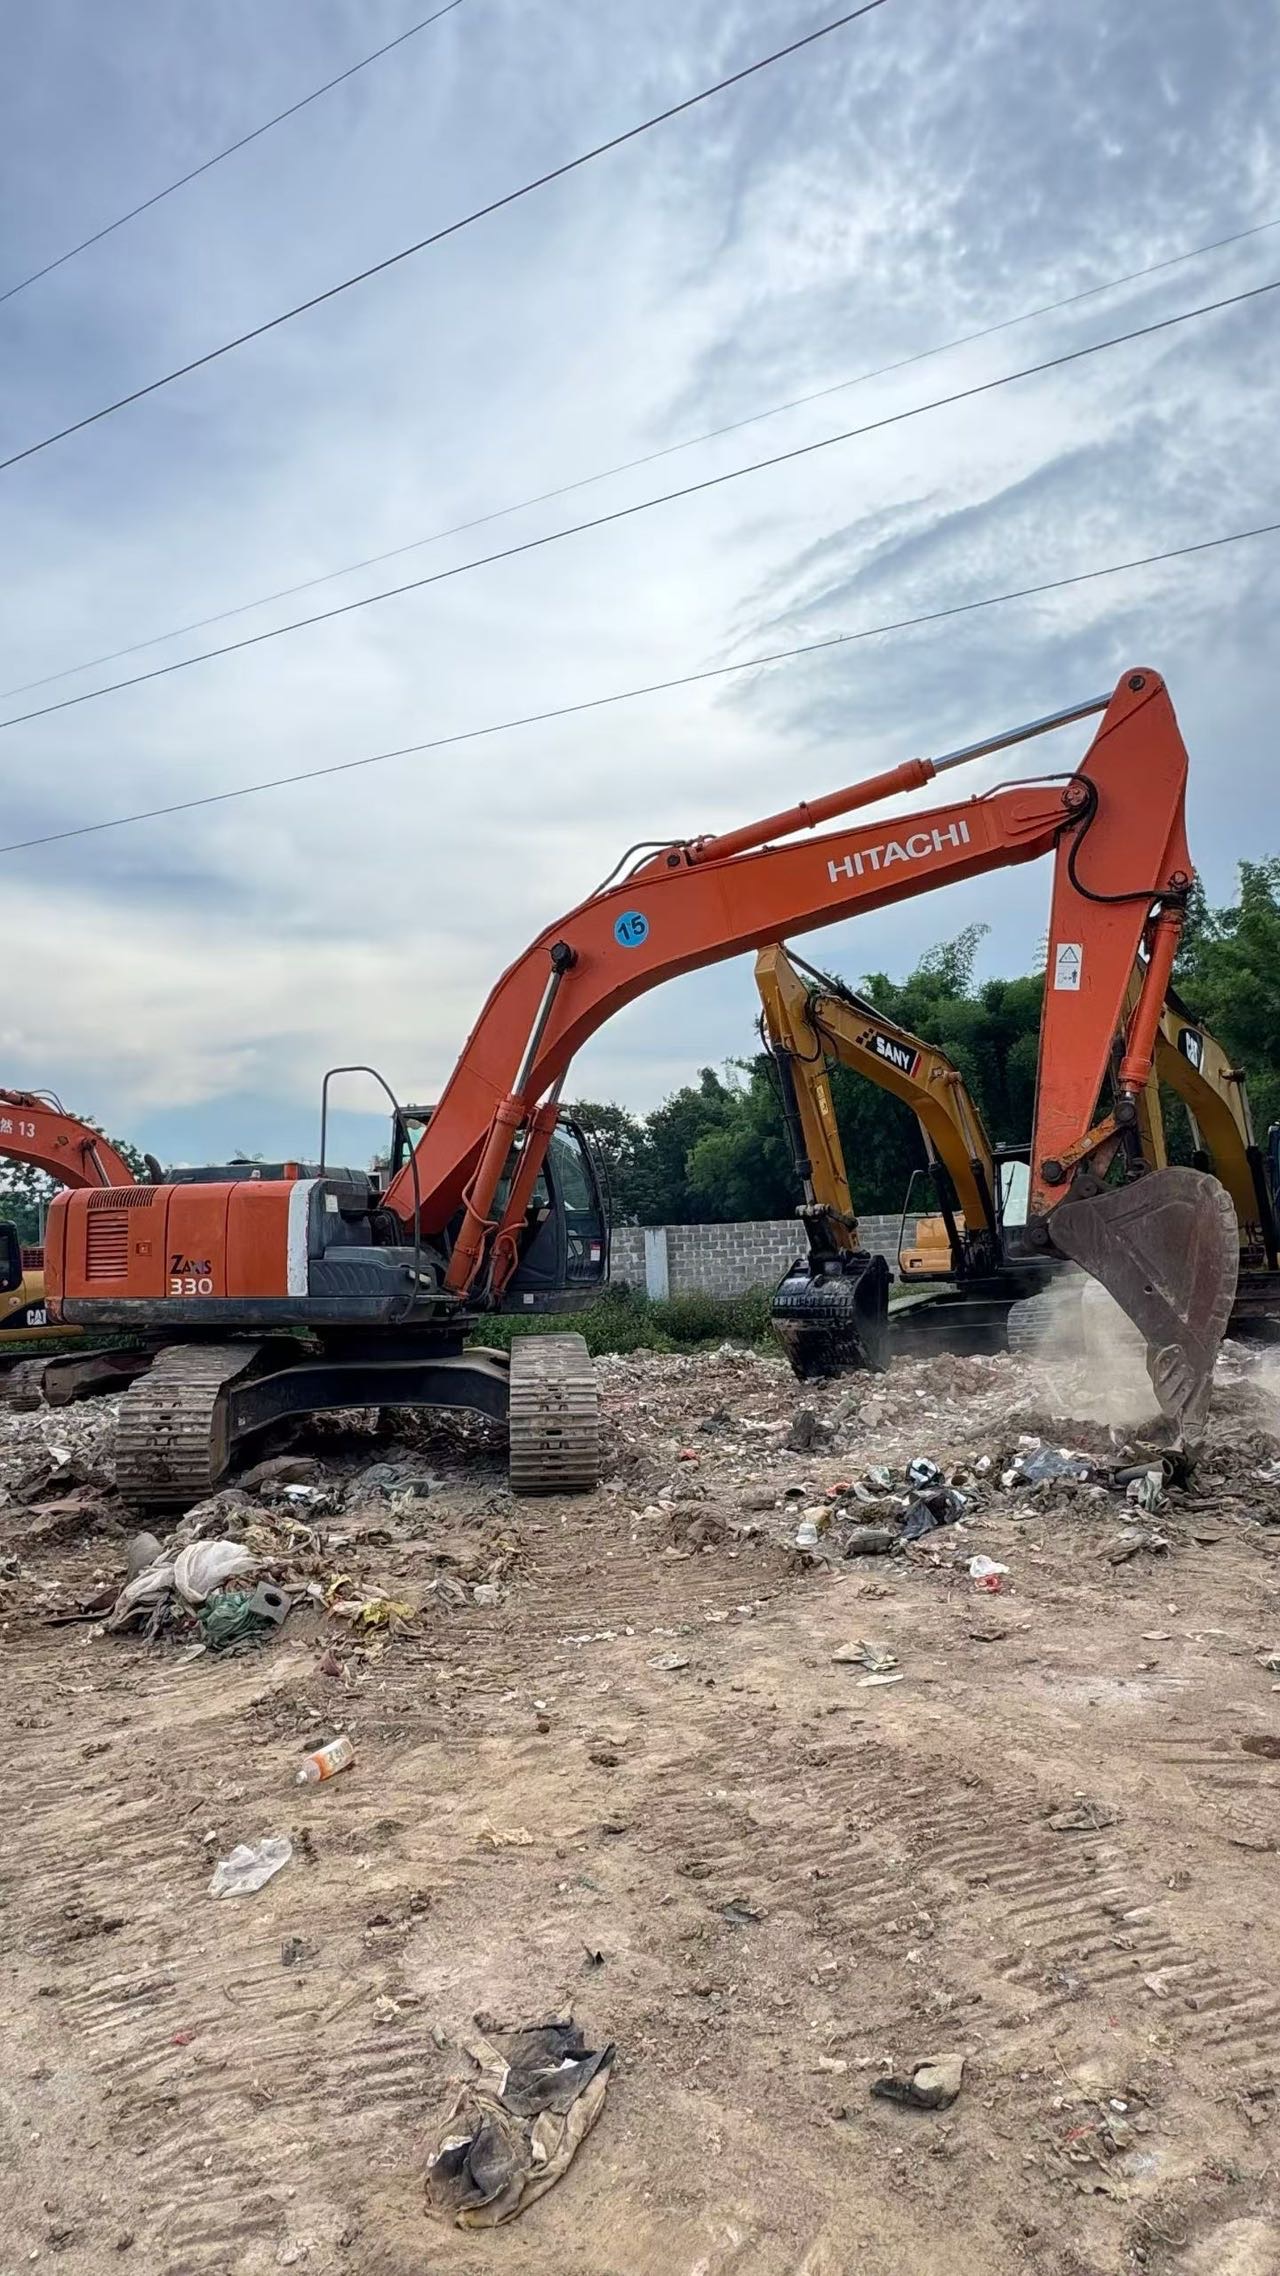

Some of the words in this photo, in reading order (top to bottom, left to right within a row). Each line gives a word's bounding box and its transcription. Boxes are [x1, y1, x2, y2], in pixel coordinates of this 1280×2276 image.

[827, 820, 971, 883] HITACHI
[617, 914, 646, 940] 15
[876, 1036, 910, 1070] SANY
[1185, 1031, 1199, 1068] CAT
[19, 1121, 36, 1138] 13
[170, 1278, 213, 1295] 330
[26, 1309, 48, 1326] CAT
